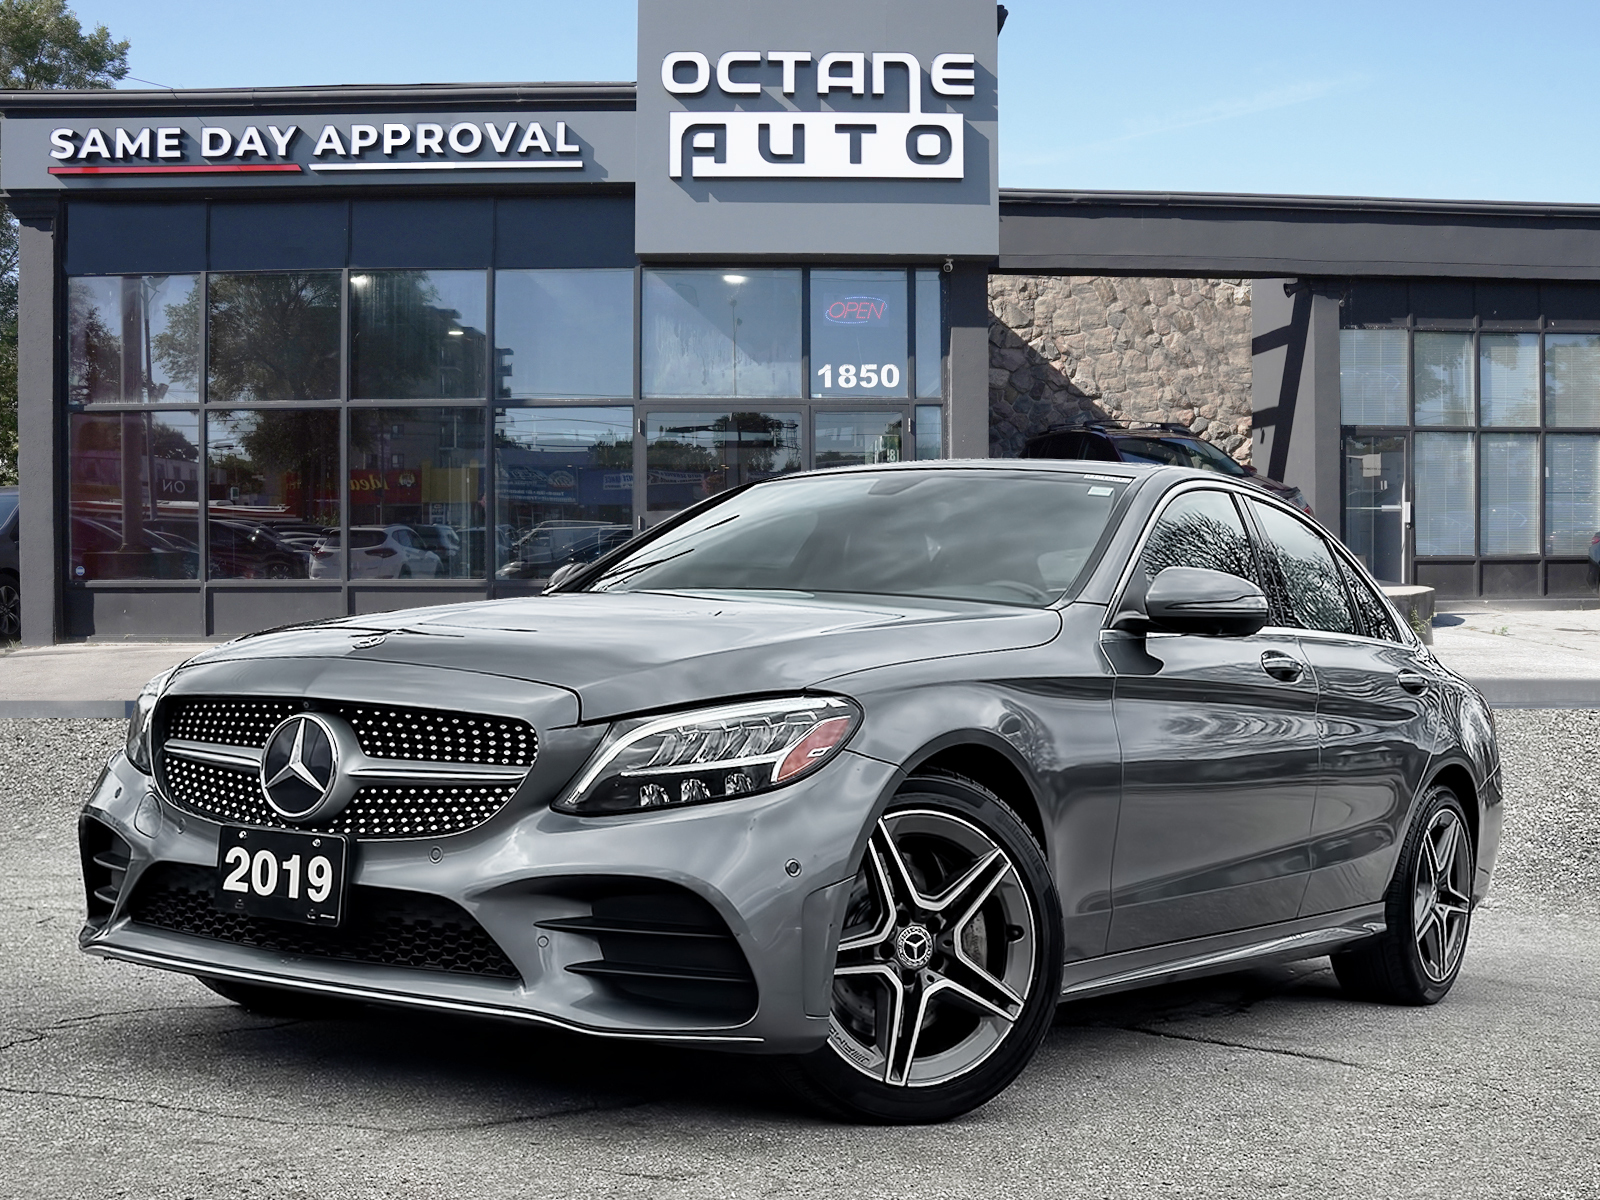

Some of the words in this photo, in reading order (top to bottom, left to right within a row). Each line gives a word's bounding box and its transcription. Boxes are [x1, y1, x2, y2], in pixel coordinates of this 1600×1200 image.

[660, 51, 976, 97] OCTANE
[49, 126, 182, 160] SAME
[201, 125, 298, 157] DAY
[312, 121, 580, 156] APPROVAL
[680, 122, 953, 176] AUTO
[828, 301, 885, 320] OPEN
[817, 363, 900, 389] 1850
[222, 845, 333, 903] 2019
